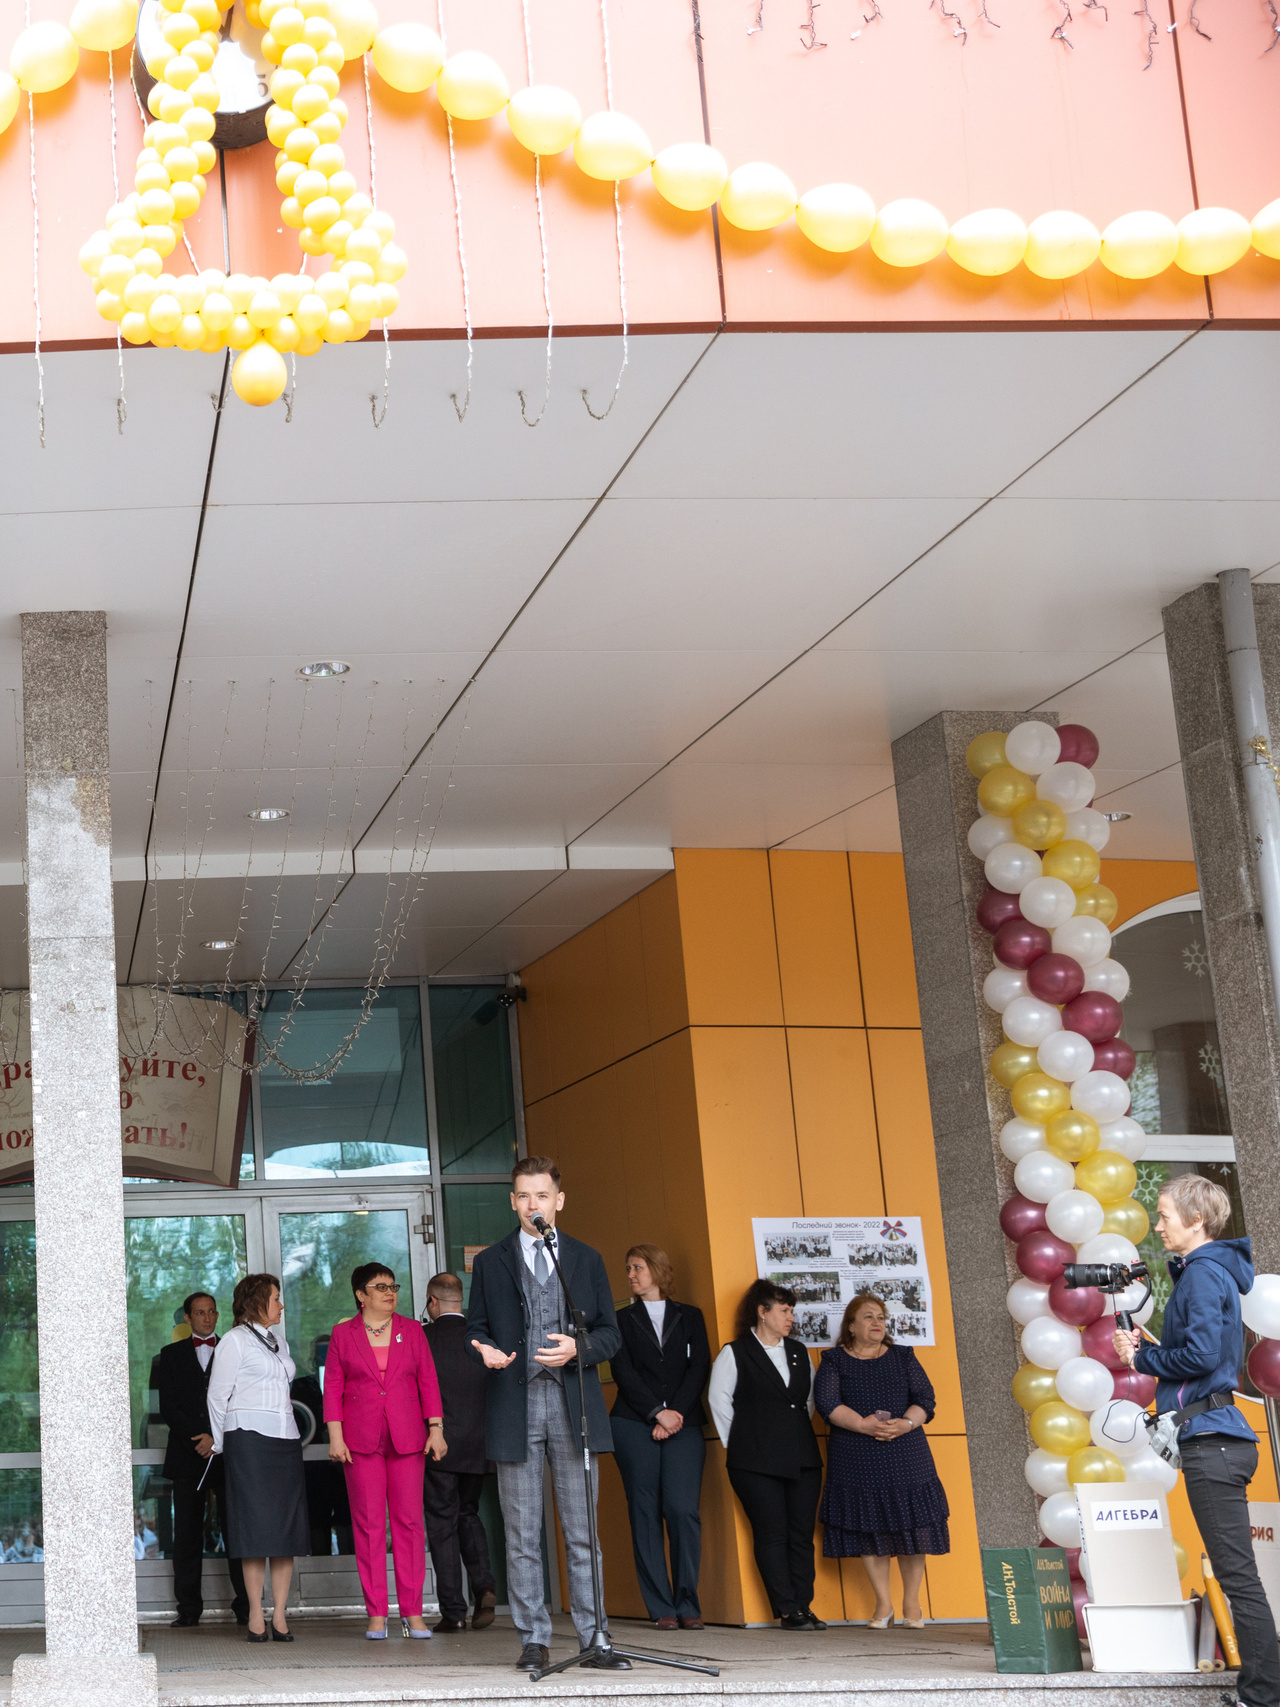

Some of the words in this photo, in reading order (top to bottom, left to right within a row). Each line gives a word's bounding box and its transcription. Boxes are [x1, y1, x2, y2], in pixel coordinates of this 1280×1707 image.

[1095, 1509, 1159, 1521] АЛГЕБРА
[1039, 1581, 1071, 1604] ВОЙНА
[1044, 1608, 1053, 1630] И
[1054, 1609, 1074, 1629] МИР
